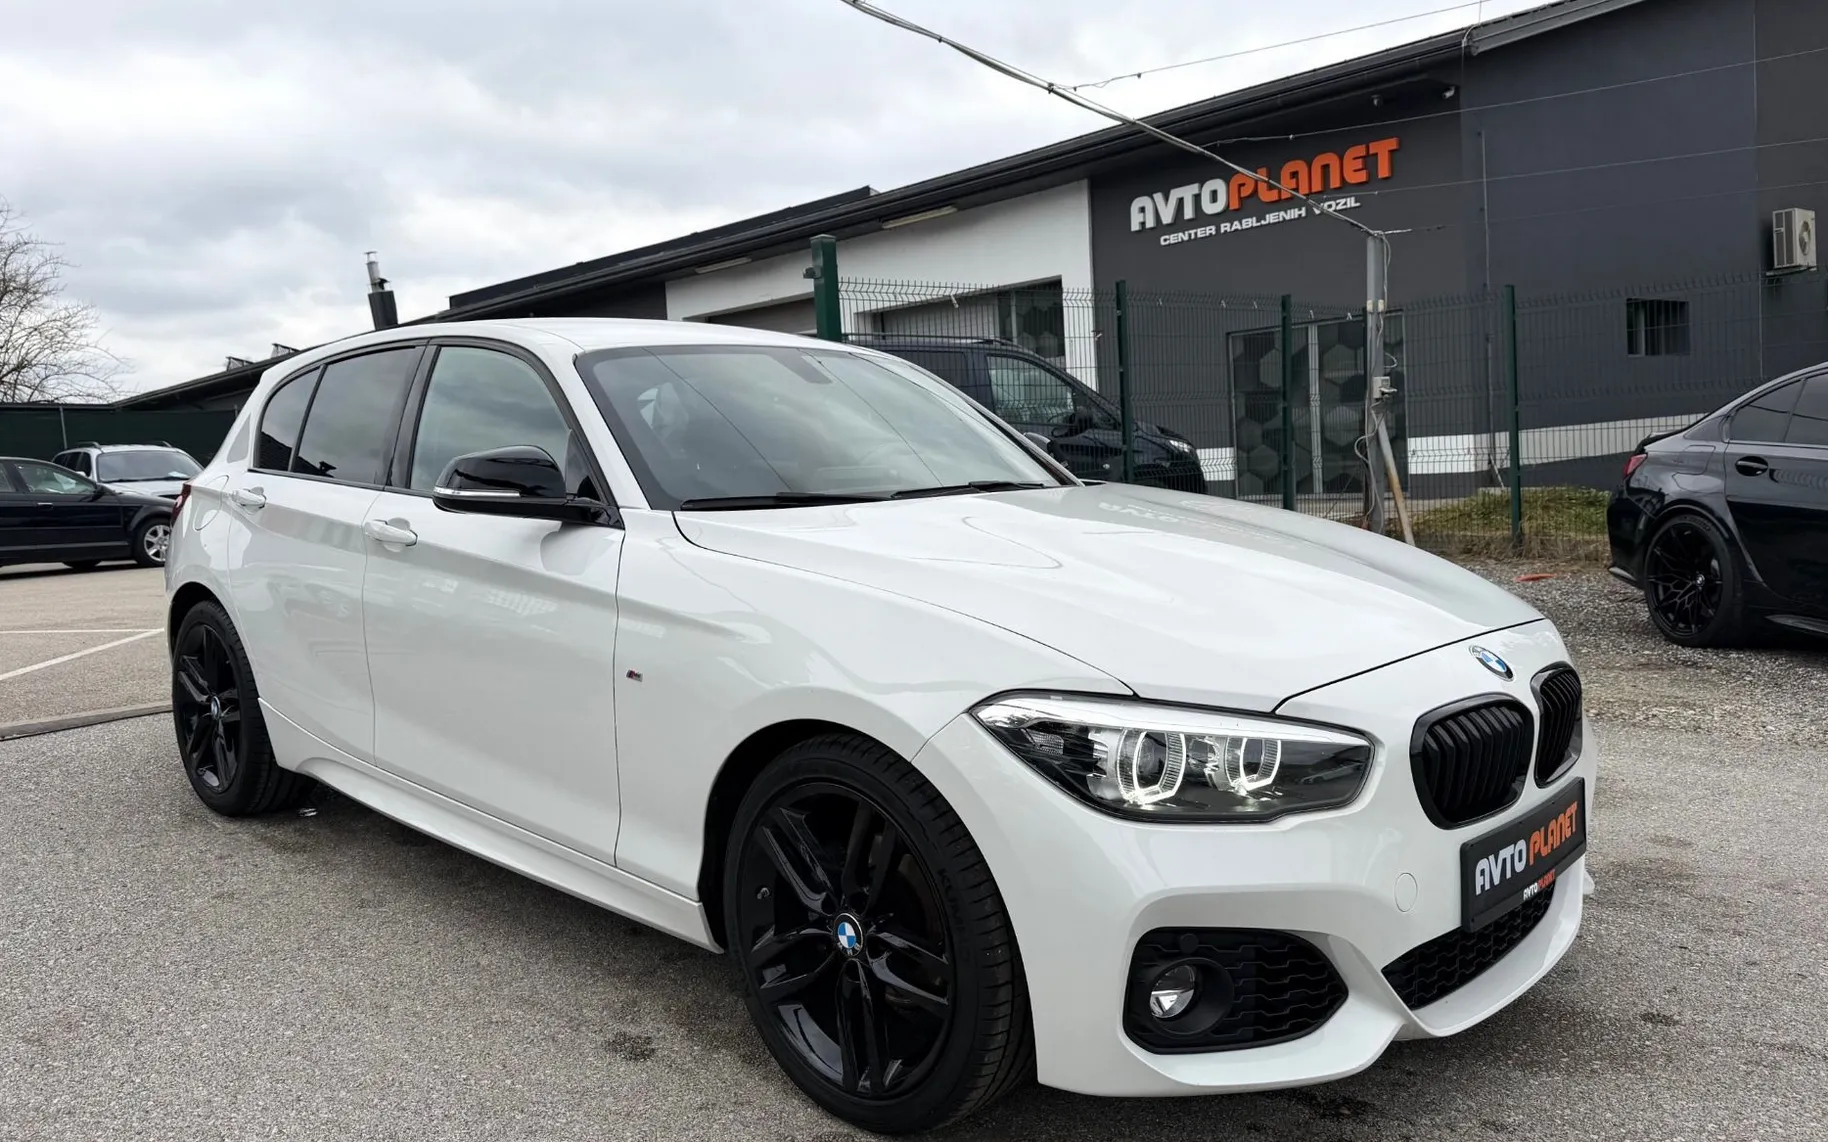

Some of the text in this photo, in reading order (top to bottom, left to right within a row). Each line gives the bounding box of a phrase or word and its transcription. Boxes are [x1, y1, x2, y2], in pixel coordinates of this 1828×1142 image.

[1160, 196, 1361, 246] CENTER RABLJENIH VOZIL
